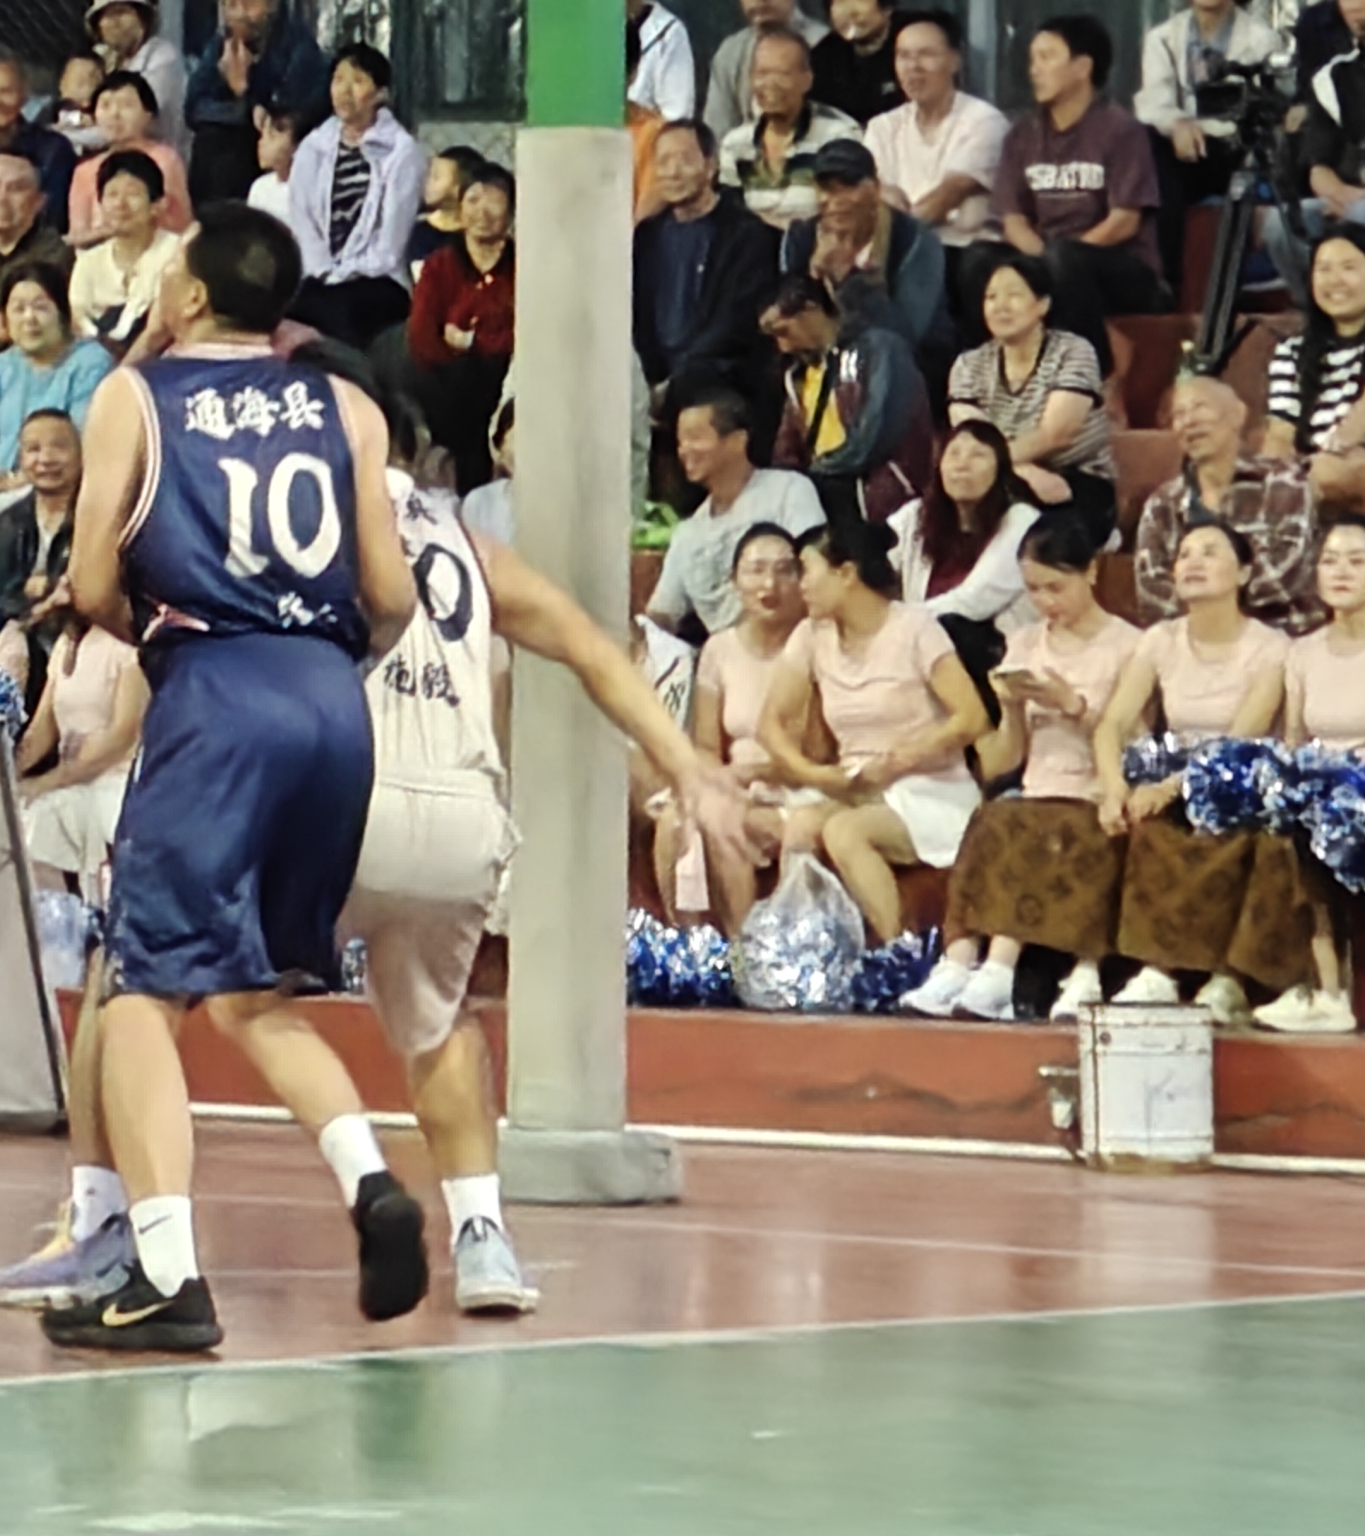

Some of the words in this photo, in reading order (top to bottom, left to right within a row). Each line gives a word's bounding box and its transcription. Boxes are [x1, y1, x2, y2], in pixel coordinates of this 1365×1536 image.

[185, 381, 325, 439] 通海县
[218, 452, 341, 578] 10
[401, 536, 473, 642] 0
